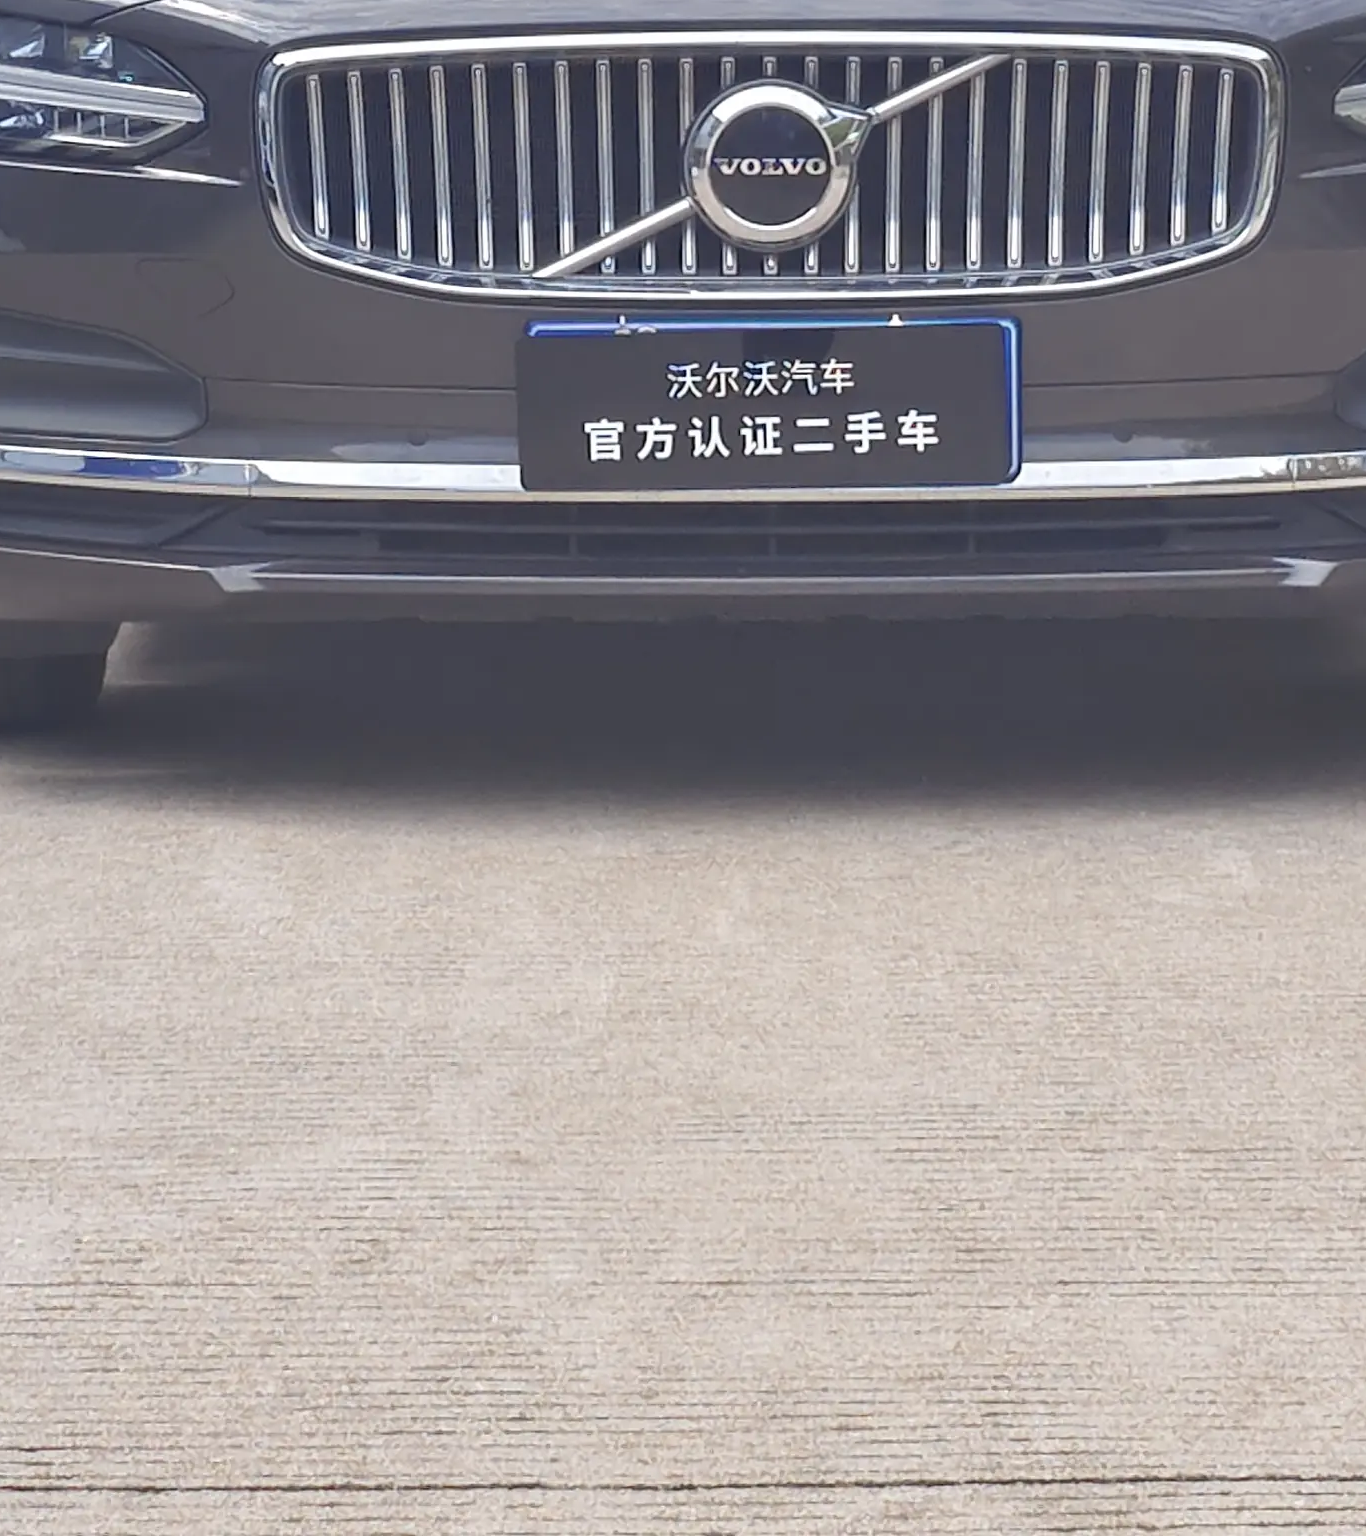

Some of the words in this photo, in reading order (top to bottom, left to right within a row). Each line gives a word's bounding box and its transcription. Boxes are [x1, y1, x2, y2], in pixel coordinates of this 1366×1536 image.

[713, 157, 827, 176] VOLVO
[666, 358, 856, 399] 沃尔沃汽车
[582, 409, 941, 462] 官方认证二手车
